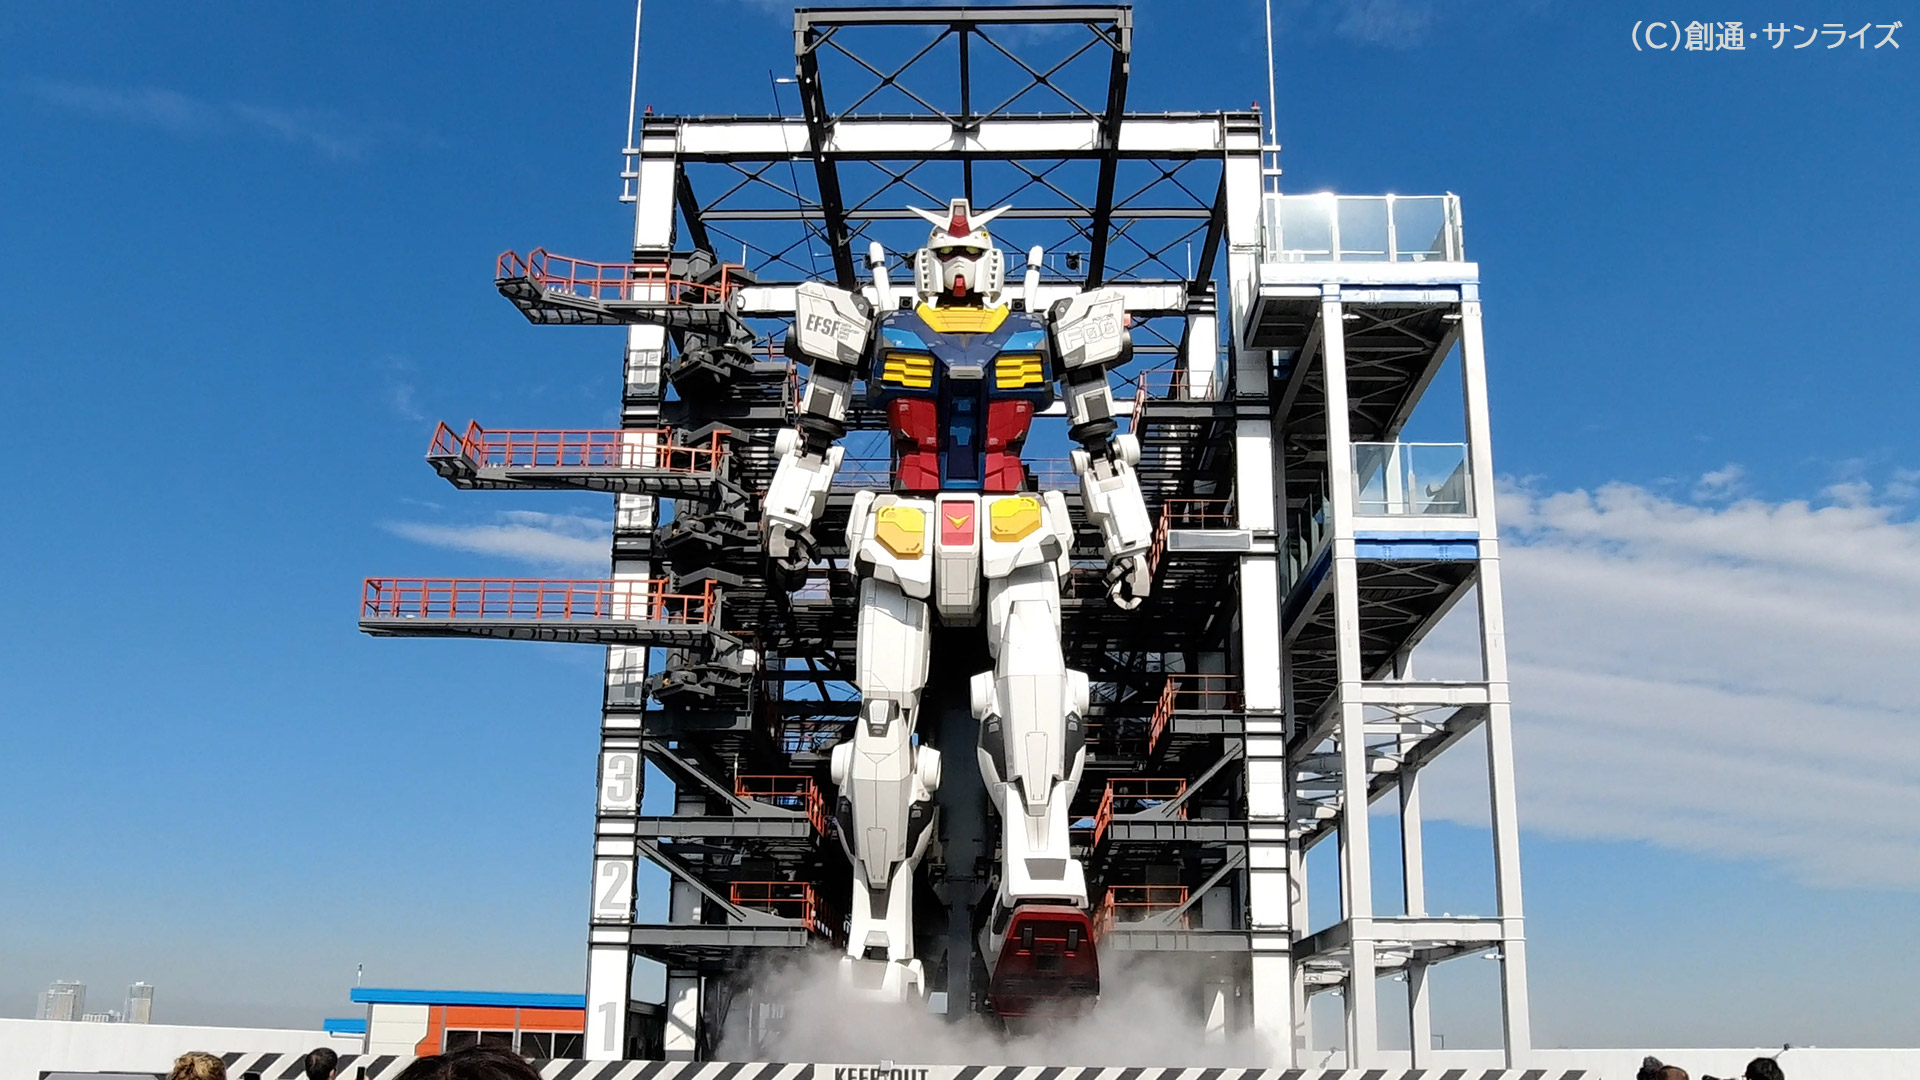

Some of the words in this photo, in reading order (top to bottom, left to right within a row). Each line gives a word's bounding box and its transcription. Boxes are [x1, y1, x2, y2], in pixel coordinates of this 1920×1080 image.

[805, 313, 841, 338] EFSF
[606, 754, 635, 802] 3
[600, 861, 629, 910] 2
[598, 1001, 618, 1052] 1
[834, 1067, 882, 1080] KEEP
